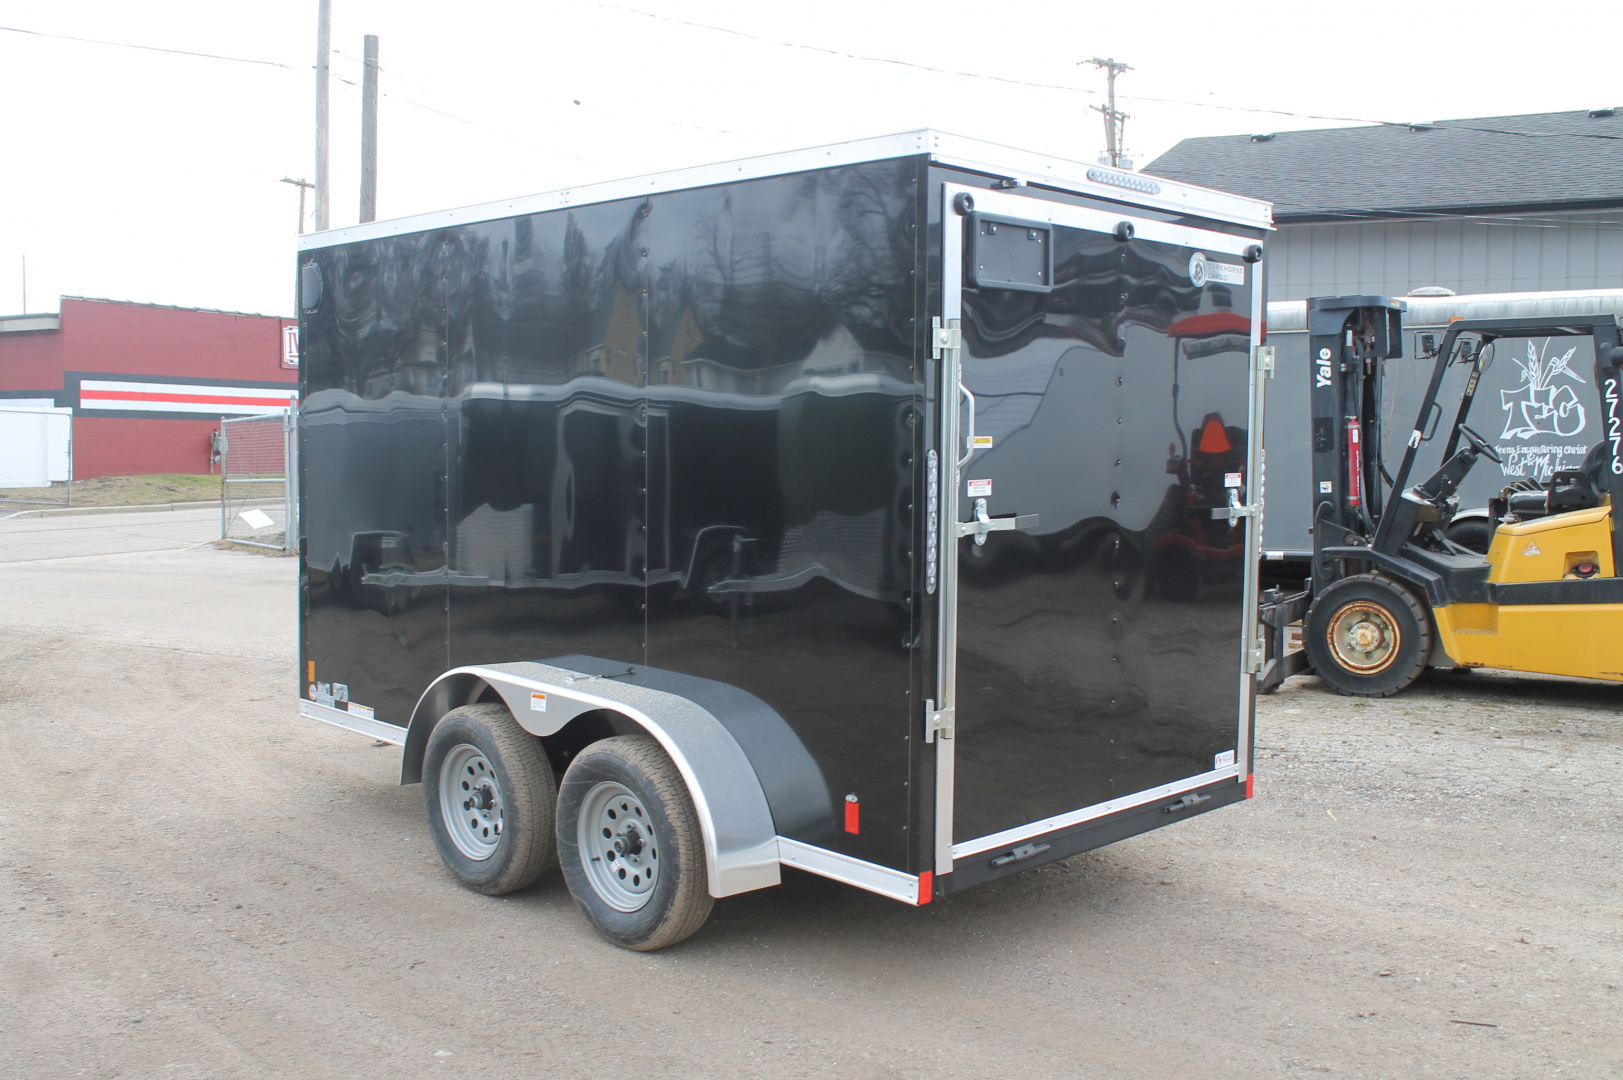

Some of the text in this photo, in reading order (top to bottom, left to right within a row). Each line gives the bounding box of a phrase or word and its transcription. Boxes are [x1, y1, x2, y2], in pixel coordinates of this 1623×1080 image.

[1207, 263, 1244, 274] DARKHORSE
[1207, 272, 1228, 281] CARGO
[1316, 347, 1332, 388] Yale
[1604, 378, 1623, 475] 27276
[1500, 454, 1527, 477] West
[1533, 454, 1580, 482] Michi
